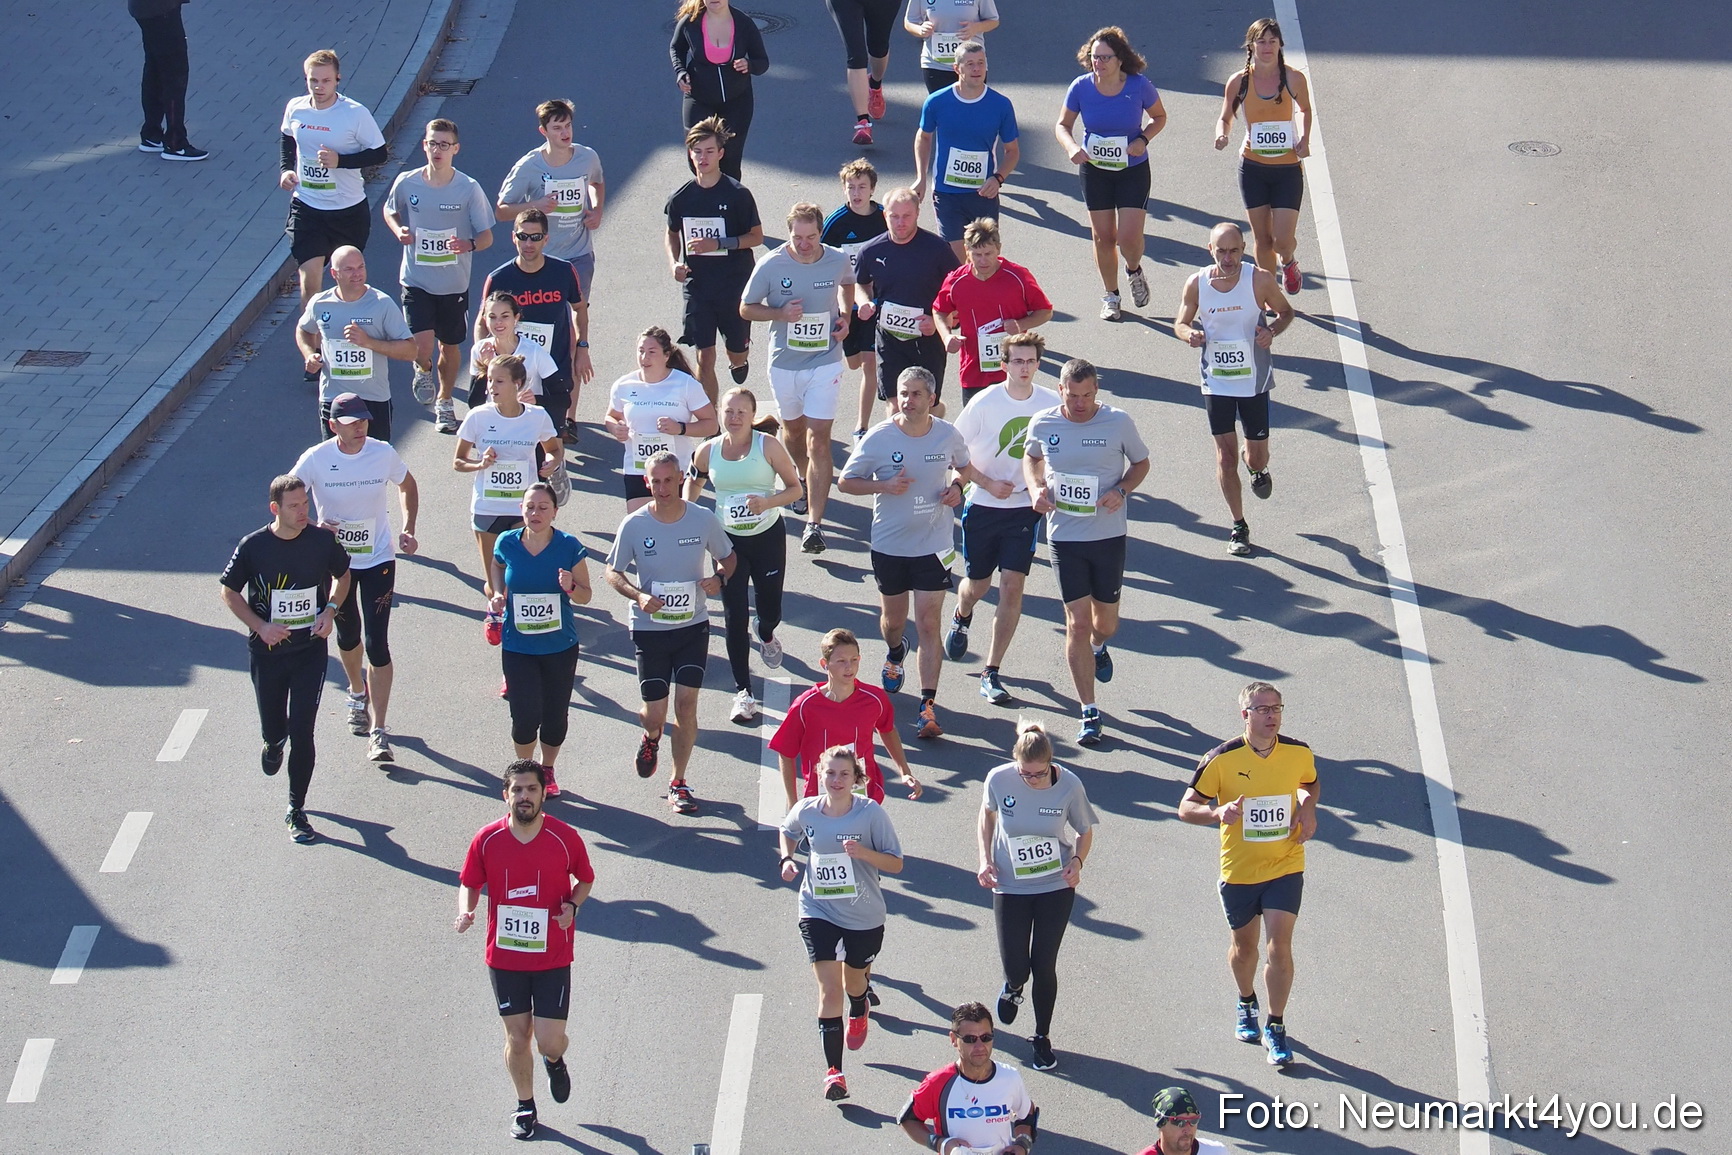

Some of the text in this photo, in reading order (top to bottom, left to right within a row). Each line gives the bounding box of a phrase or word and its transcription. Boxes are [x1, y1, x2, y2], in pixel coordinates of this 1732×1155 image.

[938, 42, 961, 53] 518
[1257, 132, 1285, 143] 5069
[1093, 145, 1122, 158] 5050
[303, 165, 330, 178] 5052
[953, 159, 982, 174] 5068
[551, 189, 581, 201] 5195
[691, 227, 721, 239] 5184
[886, 314, 916, 330] 5222
[794, 323, 825, 336] 5157
[335, 350, 366, 363] 5158
[985, 344, 1000, 356] 51
[1214, 351, 1245, 364] 5053
[491, 471, 522, 485] 5083
[1060, 484, 1091, 500] 5165
[913, 496, 926, 504] 19.
[729, 504, 762, 519] 522
[338, 528, 369, 542] 5086
[278, 599, 311, 614] 5156
[658, 593, 690, 608] 5022
[521, 603, 554, 618] 5024
[1250, 808, 1285, 823] 5016
[1018, 841, 1053, 862] 5163
[816, 865, 847, 881] 5013
[1029, 865, 1048, 874] Selina
[504, 917, 540, 935] 5118
[513, 940, 529, 948] Saad
